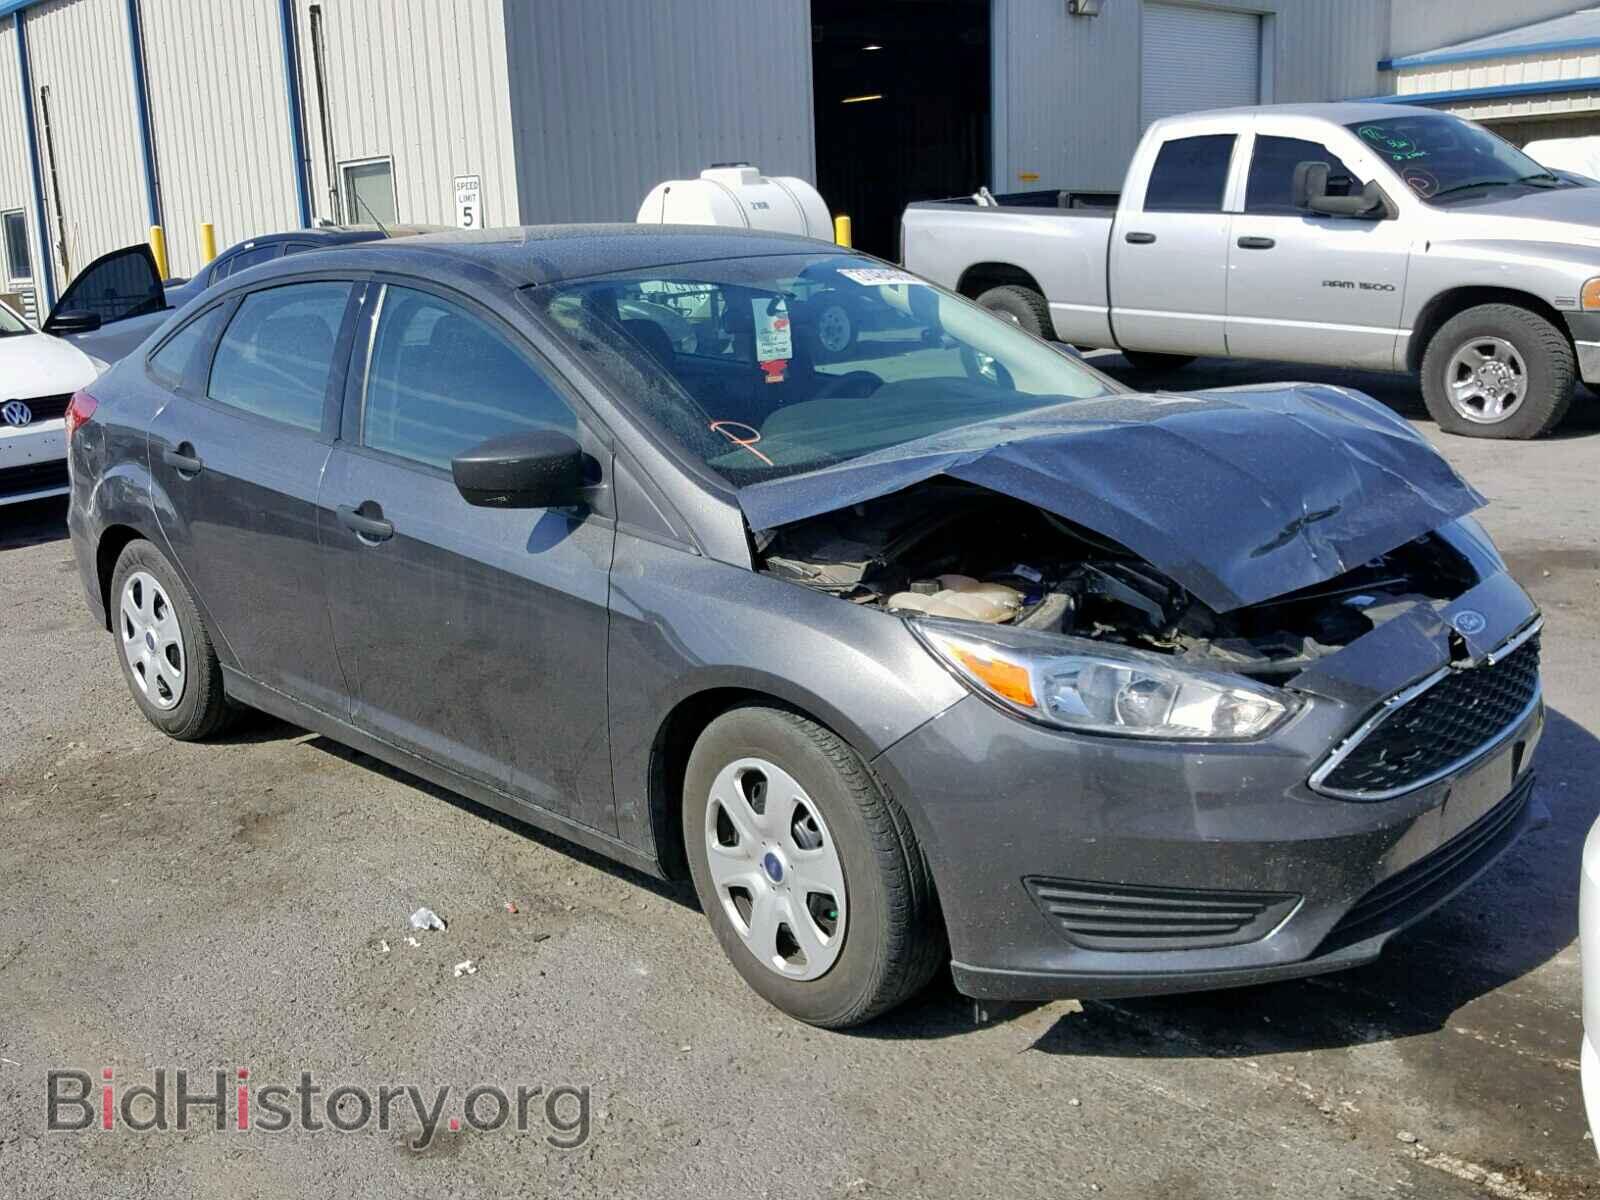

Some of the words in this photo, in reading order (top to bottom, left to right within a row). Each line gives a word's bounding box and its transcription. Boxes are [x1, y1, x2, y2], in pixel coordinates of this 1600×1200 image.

[456, 181, 478, 191] SPEED
[458, 193, 476, 203] LIMIT
[463, 206, 473, 227] 5
[1358, 281, 1396, 291] 1500
